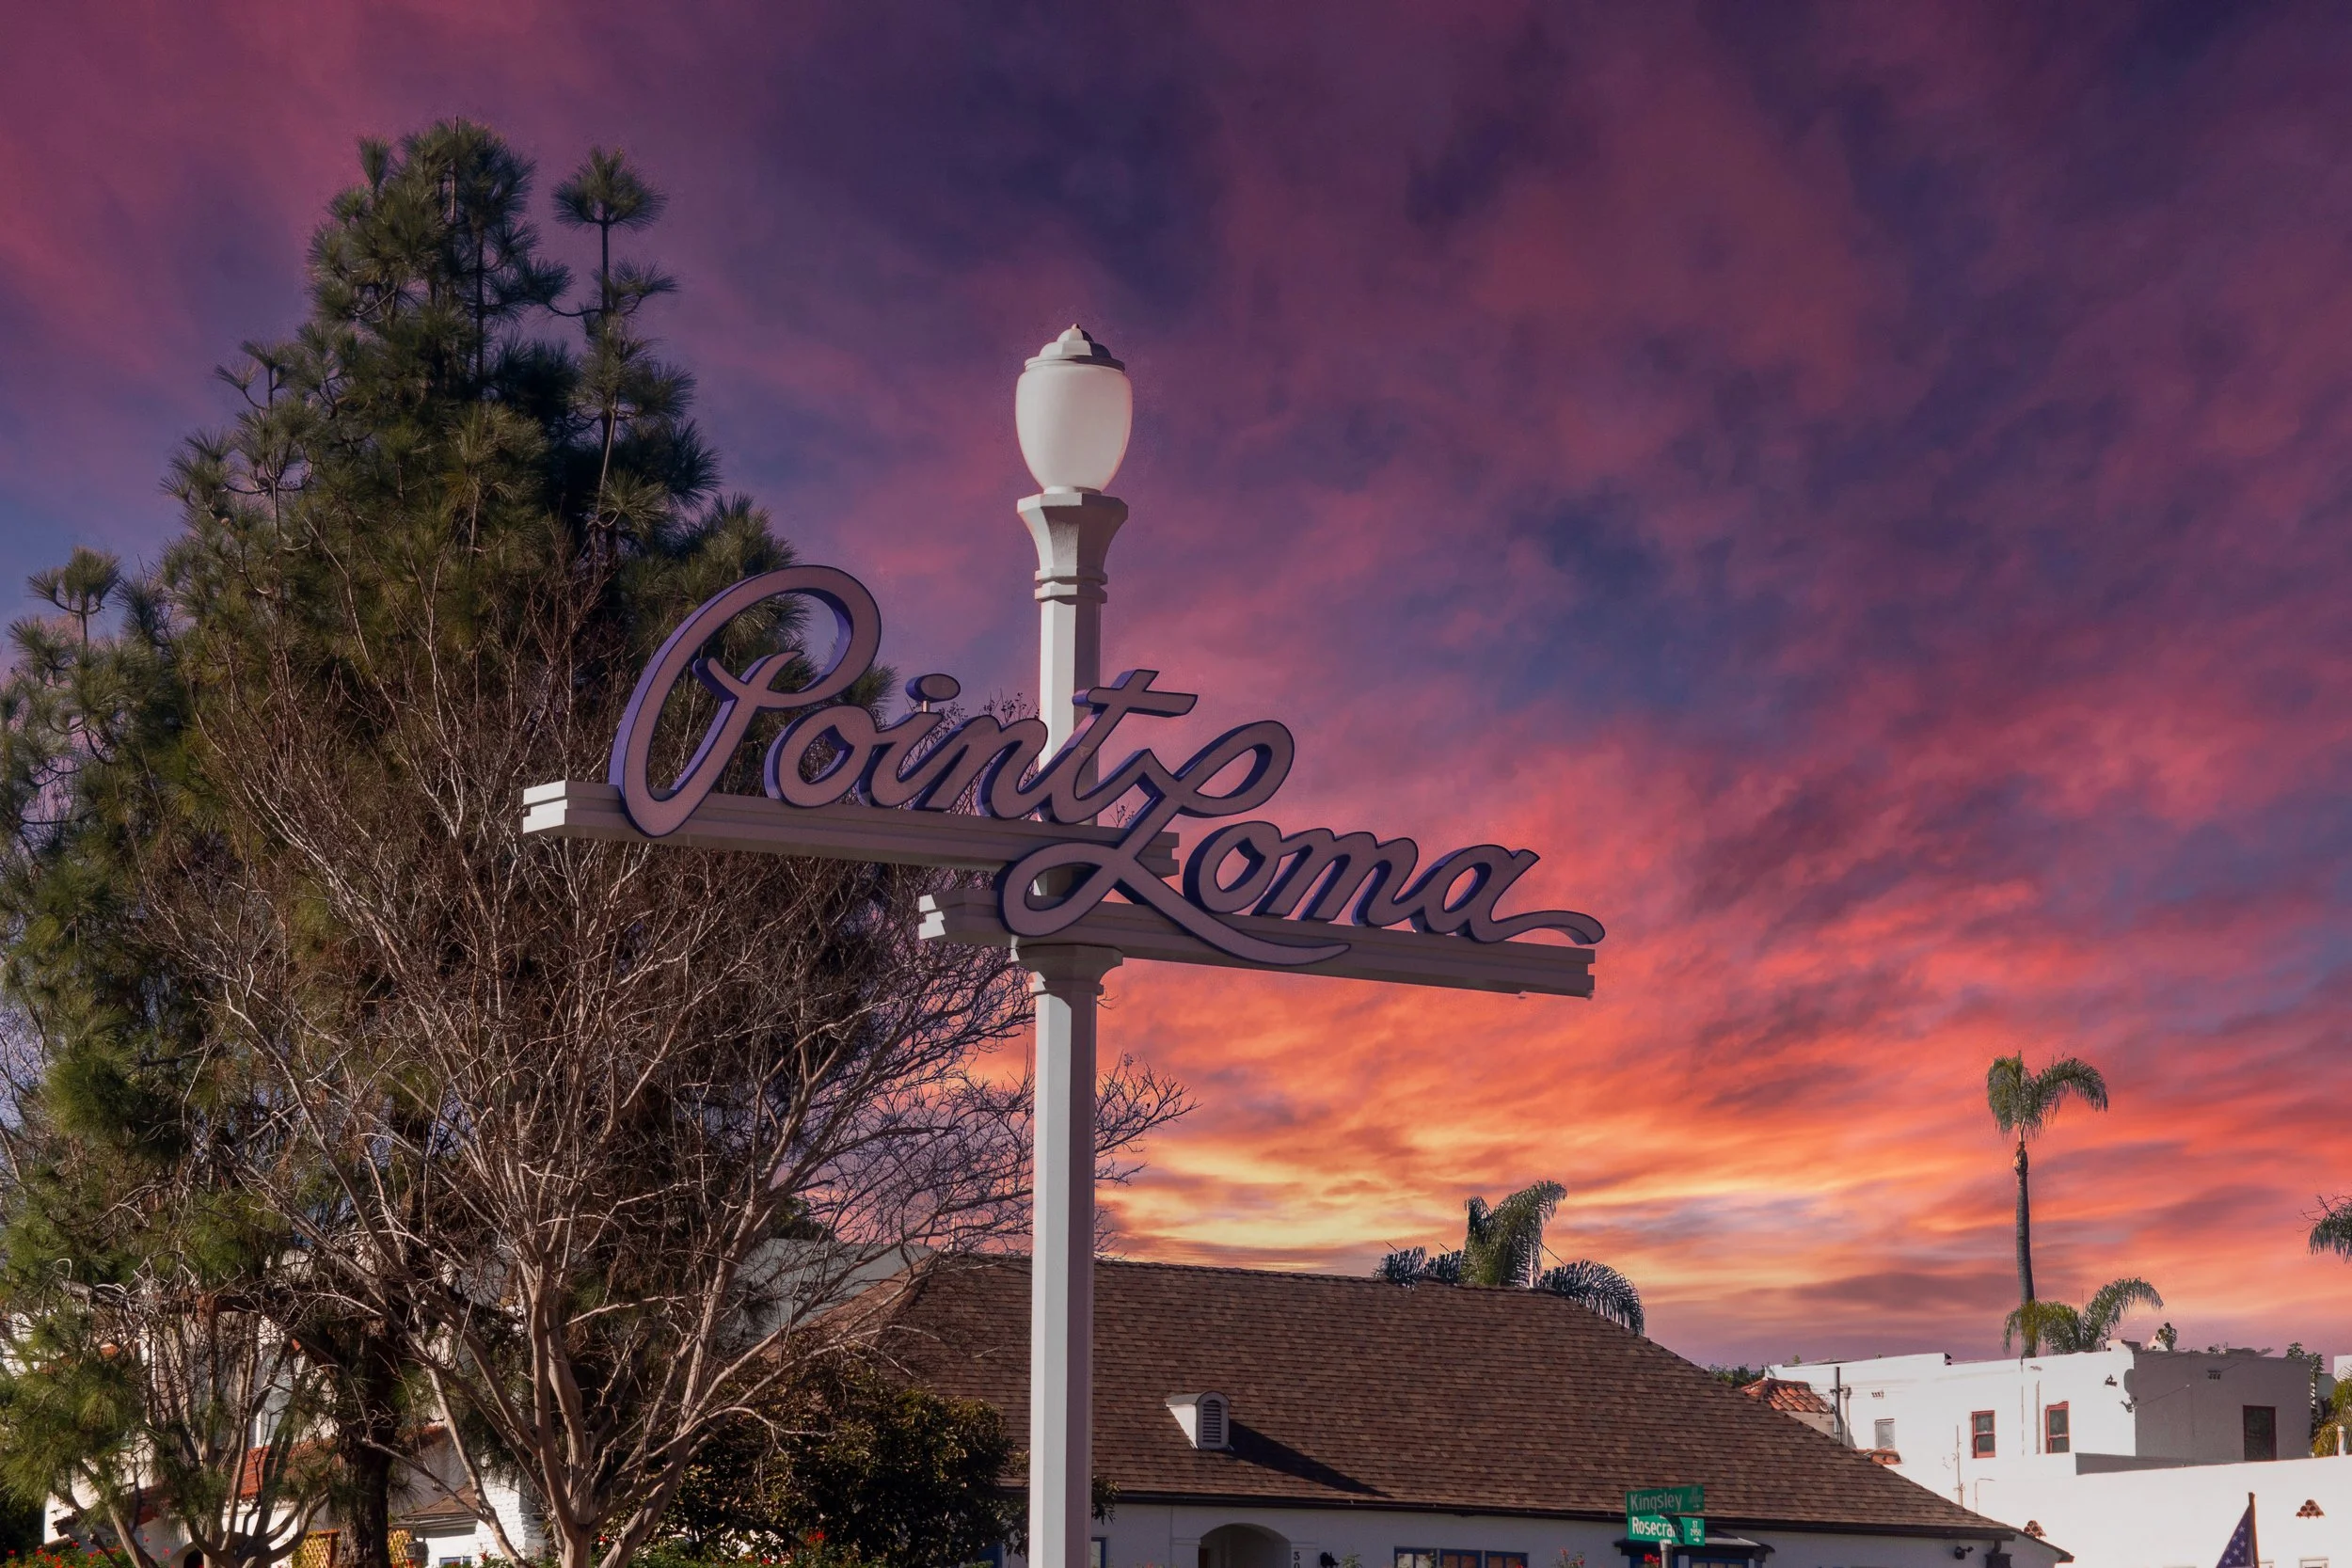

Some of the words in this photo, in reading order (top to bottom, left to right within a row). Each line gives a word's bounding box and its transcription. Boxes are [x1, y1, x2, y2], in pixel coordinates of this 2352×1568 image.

[610, 565, 1197, 837] Point
[999, 721, 1605, 966] Loma
[1630, 1492, 1682, 1515] Kingsley
[1631, 1516, 1684, 1538] Rosecrans
